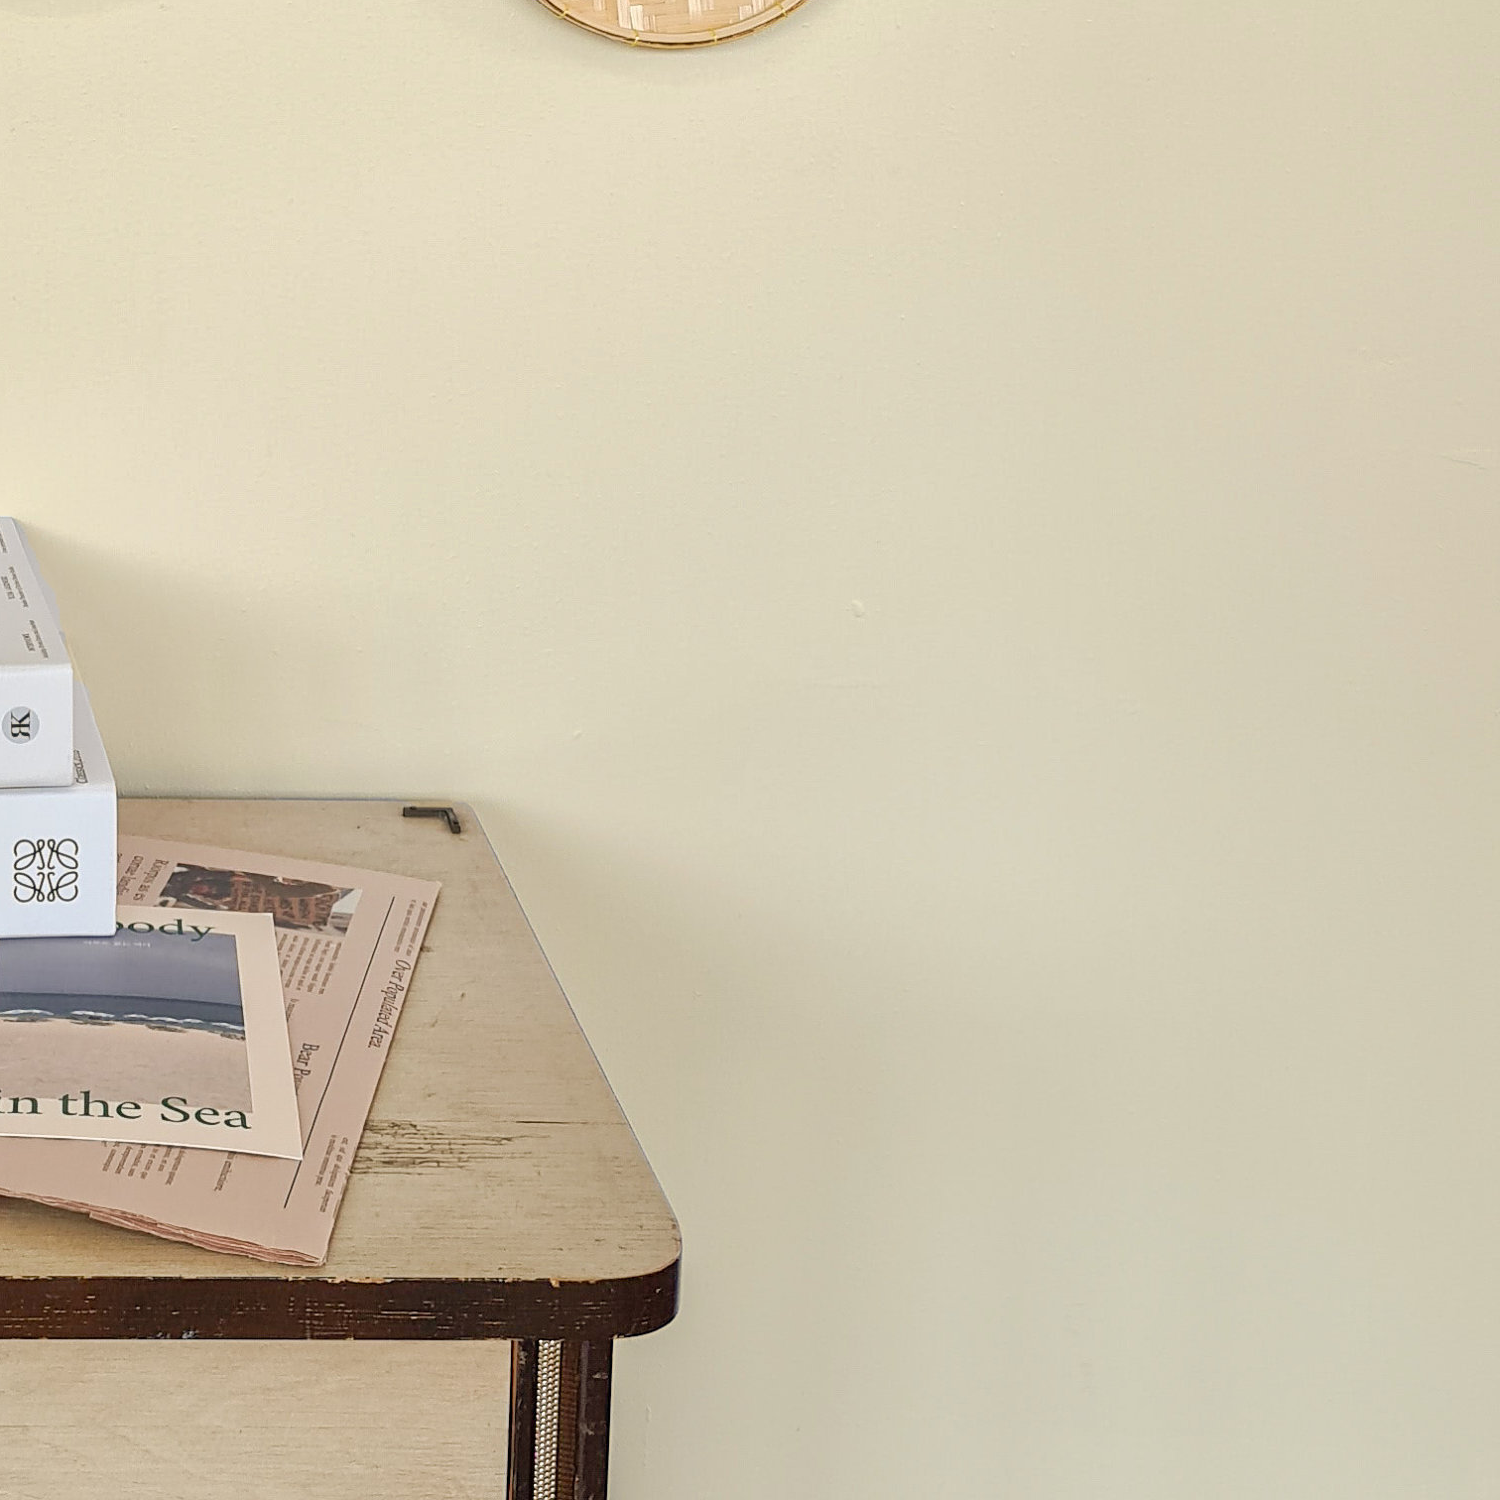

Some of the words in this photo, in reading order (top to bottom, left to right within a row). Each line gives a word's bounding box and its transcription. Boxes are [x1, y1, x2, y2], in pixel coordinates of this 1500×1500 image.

[390, 959, 412, 981] Over
[380, 980, 405, 1029] Populated
[296, 1042, 320, 1067] Bear
[58, 1090, 142, 1120] the
[160, 1096, 252, 1130] Sea
